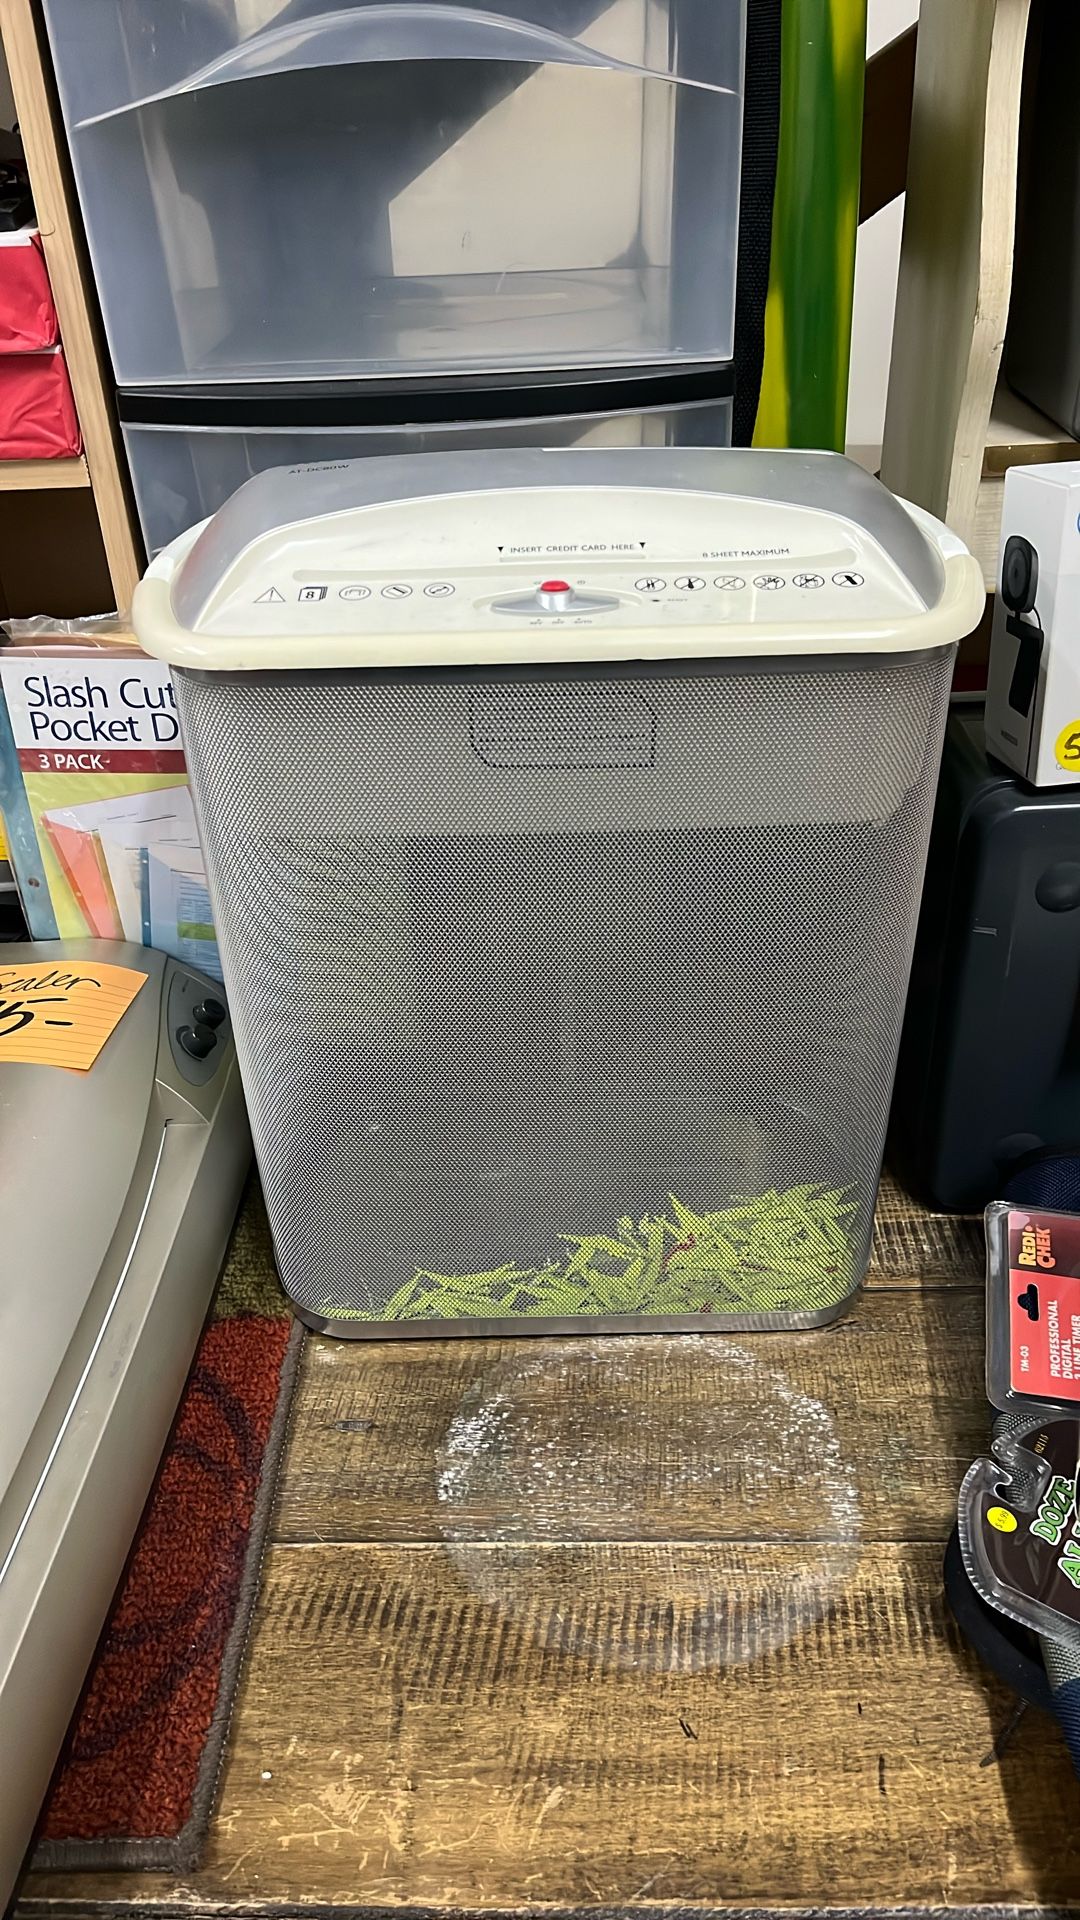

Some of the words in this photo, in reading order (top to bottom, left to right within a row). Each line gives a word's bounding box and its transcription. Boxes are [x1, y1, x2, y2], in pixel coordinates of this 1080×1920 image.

[510, 546, 542, 554] INSERT
[741, 548, 790, 557] MAXIMUM
[24, 675, 108, 710] Slash
[119, 678, 177, 709] Cut
[30, 711, 141, 742] Pocket
[38, 753, 50, 769] 3
[55, 753, 105, 770] PACK
[1036, 1228, 1056, 1269] CHEK
[1048, 1299, 1060, 1378] PROFESSIONAL
[1071, 1315, 1080, 1346] TIMER
[1020, 1345, 1030, 1373] TM-03
[1061, 1338, 1073, 1380] DIGITAL
